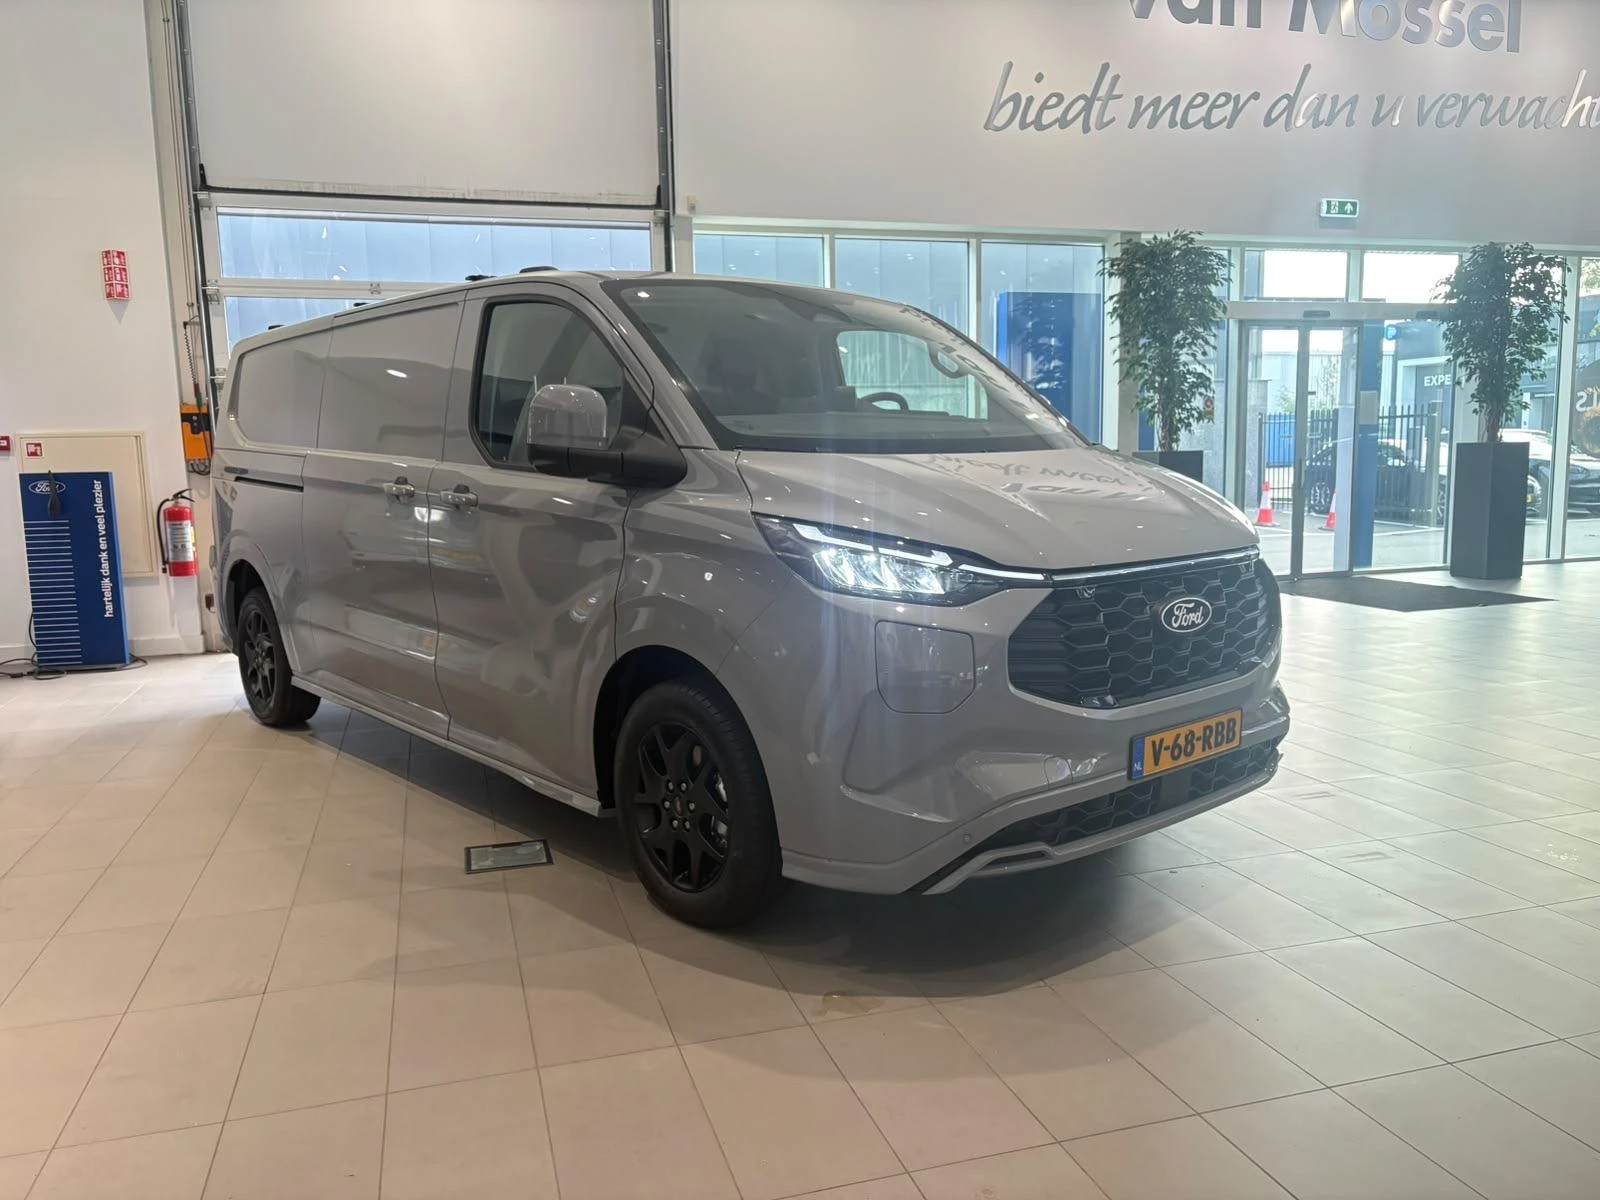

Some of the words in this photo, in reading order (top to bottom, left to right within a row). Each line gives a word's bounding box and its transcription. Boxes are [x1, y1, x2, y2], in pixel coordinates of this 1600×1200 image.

[984, 60, 1123, 134] biedt
[1127, 91, 1261, 130] meer
[1263, 63, 1359, 132] dan
[1372, 92, 1406, 128] u
[92, 480, 106, 513] plezier
[95, 515, 107, 536] veel
[98, 537, 108, 550] en
[98, 551, 110, 576] dank
[100, 577, 114, 618] hartelijk
[1171, 602, 1204, 628] Ford
[1152, 718, 1236, 767] V-68-RBB
